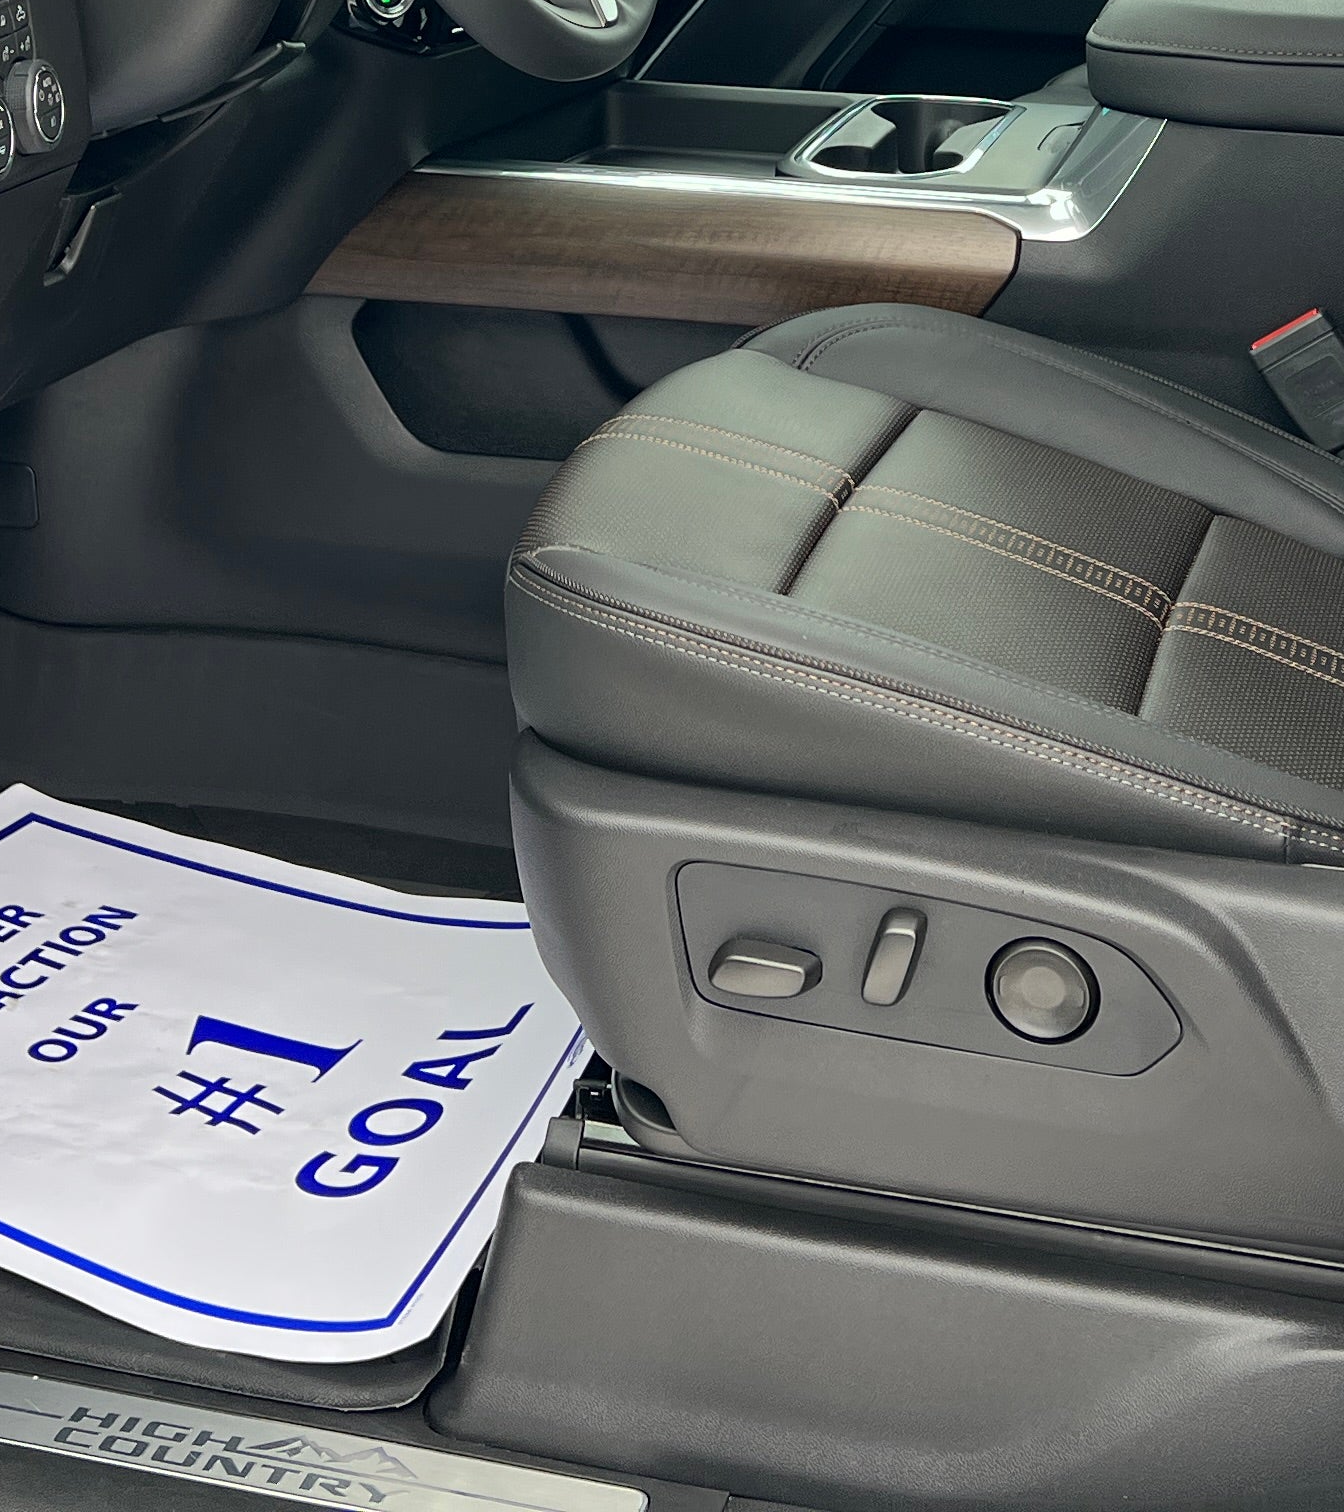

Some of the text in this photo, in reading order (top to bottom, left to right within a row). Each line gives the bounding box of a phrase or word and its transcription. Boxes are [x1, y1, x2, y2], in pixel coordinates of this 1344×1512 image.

[27, 995, 139, 1063] OUR
[152, 1015, 362, 1135] #1
[296, 1003, 533, 1198] GOAL
[55, 1426, 410, 1504] COUNTRY
[67, 1406, 242, 1452] HIGH
